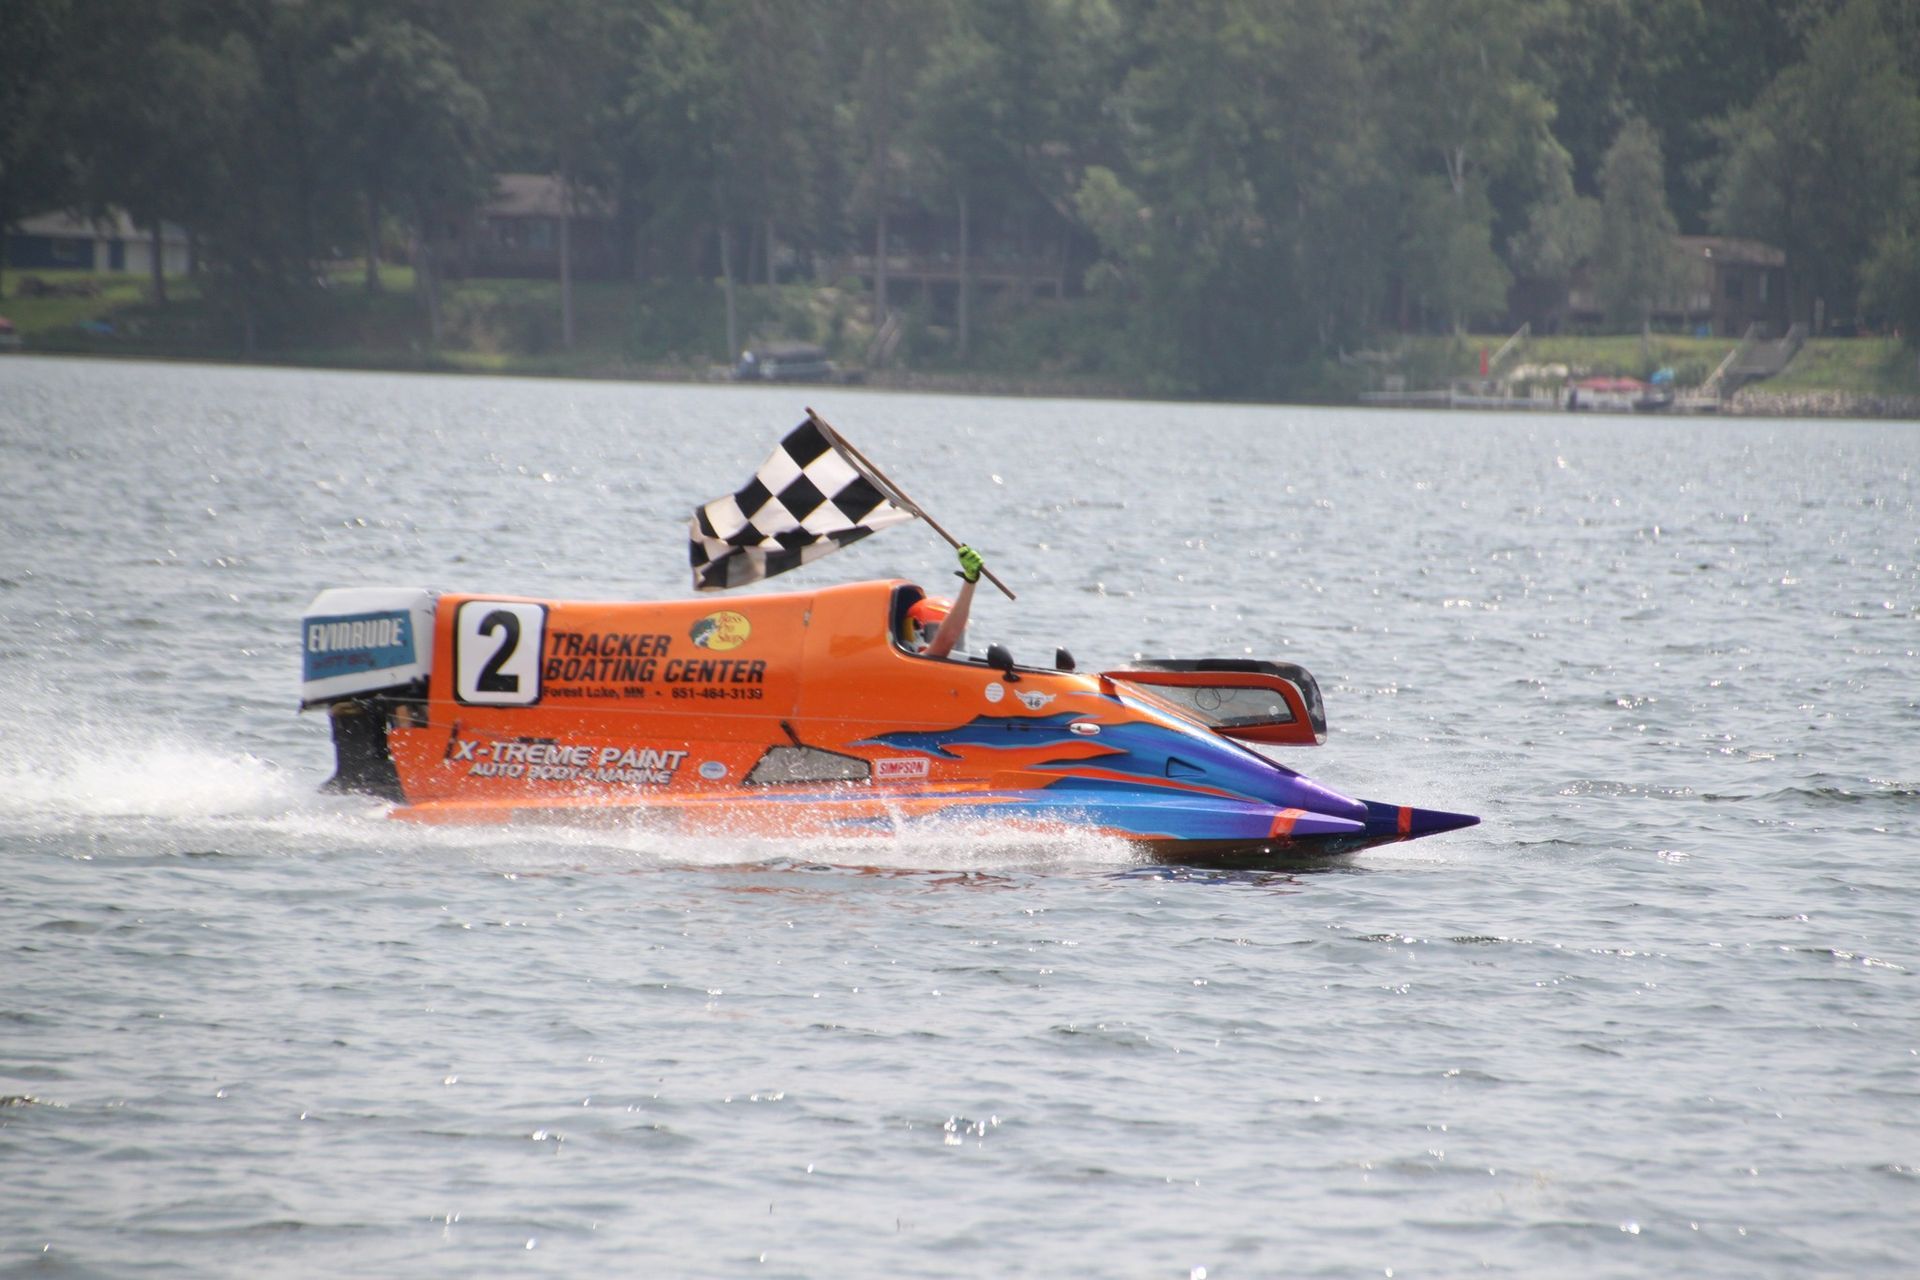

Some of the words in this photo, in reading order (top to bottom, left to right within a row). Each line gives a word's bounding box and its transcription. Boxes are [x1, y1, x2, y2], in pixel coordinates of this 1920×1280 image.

[475, 609, 520, 693] 2
[552, 632, 672, 657] TRACKER
[545, 657, 657, 681] BOATING
[664, 659, 766, 683] CENTER
[544, 686, 583, 697] Forest
[623, 687, 645, 698] MN
[453, 740, 591, 766] X-TREME
[598, 747, 688, 770] PAINT
[468, 762, 524, 778] AUTO
[527, 765, 580, 780] BODY
[595, 768, 672, 784] MARINE
[879, 762, 924, 774] SIMPSON
